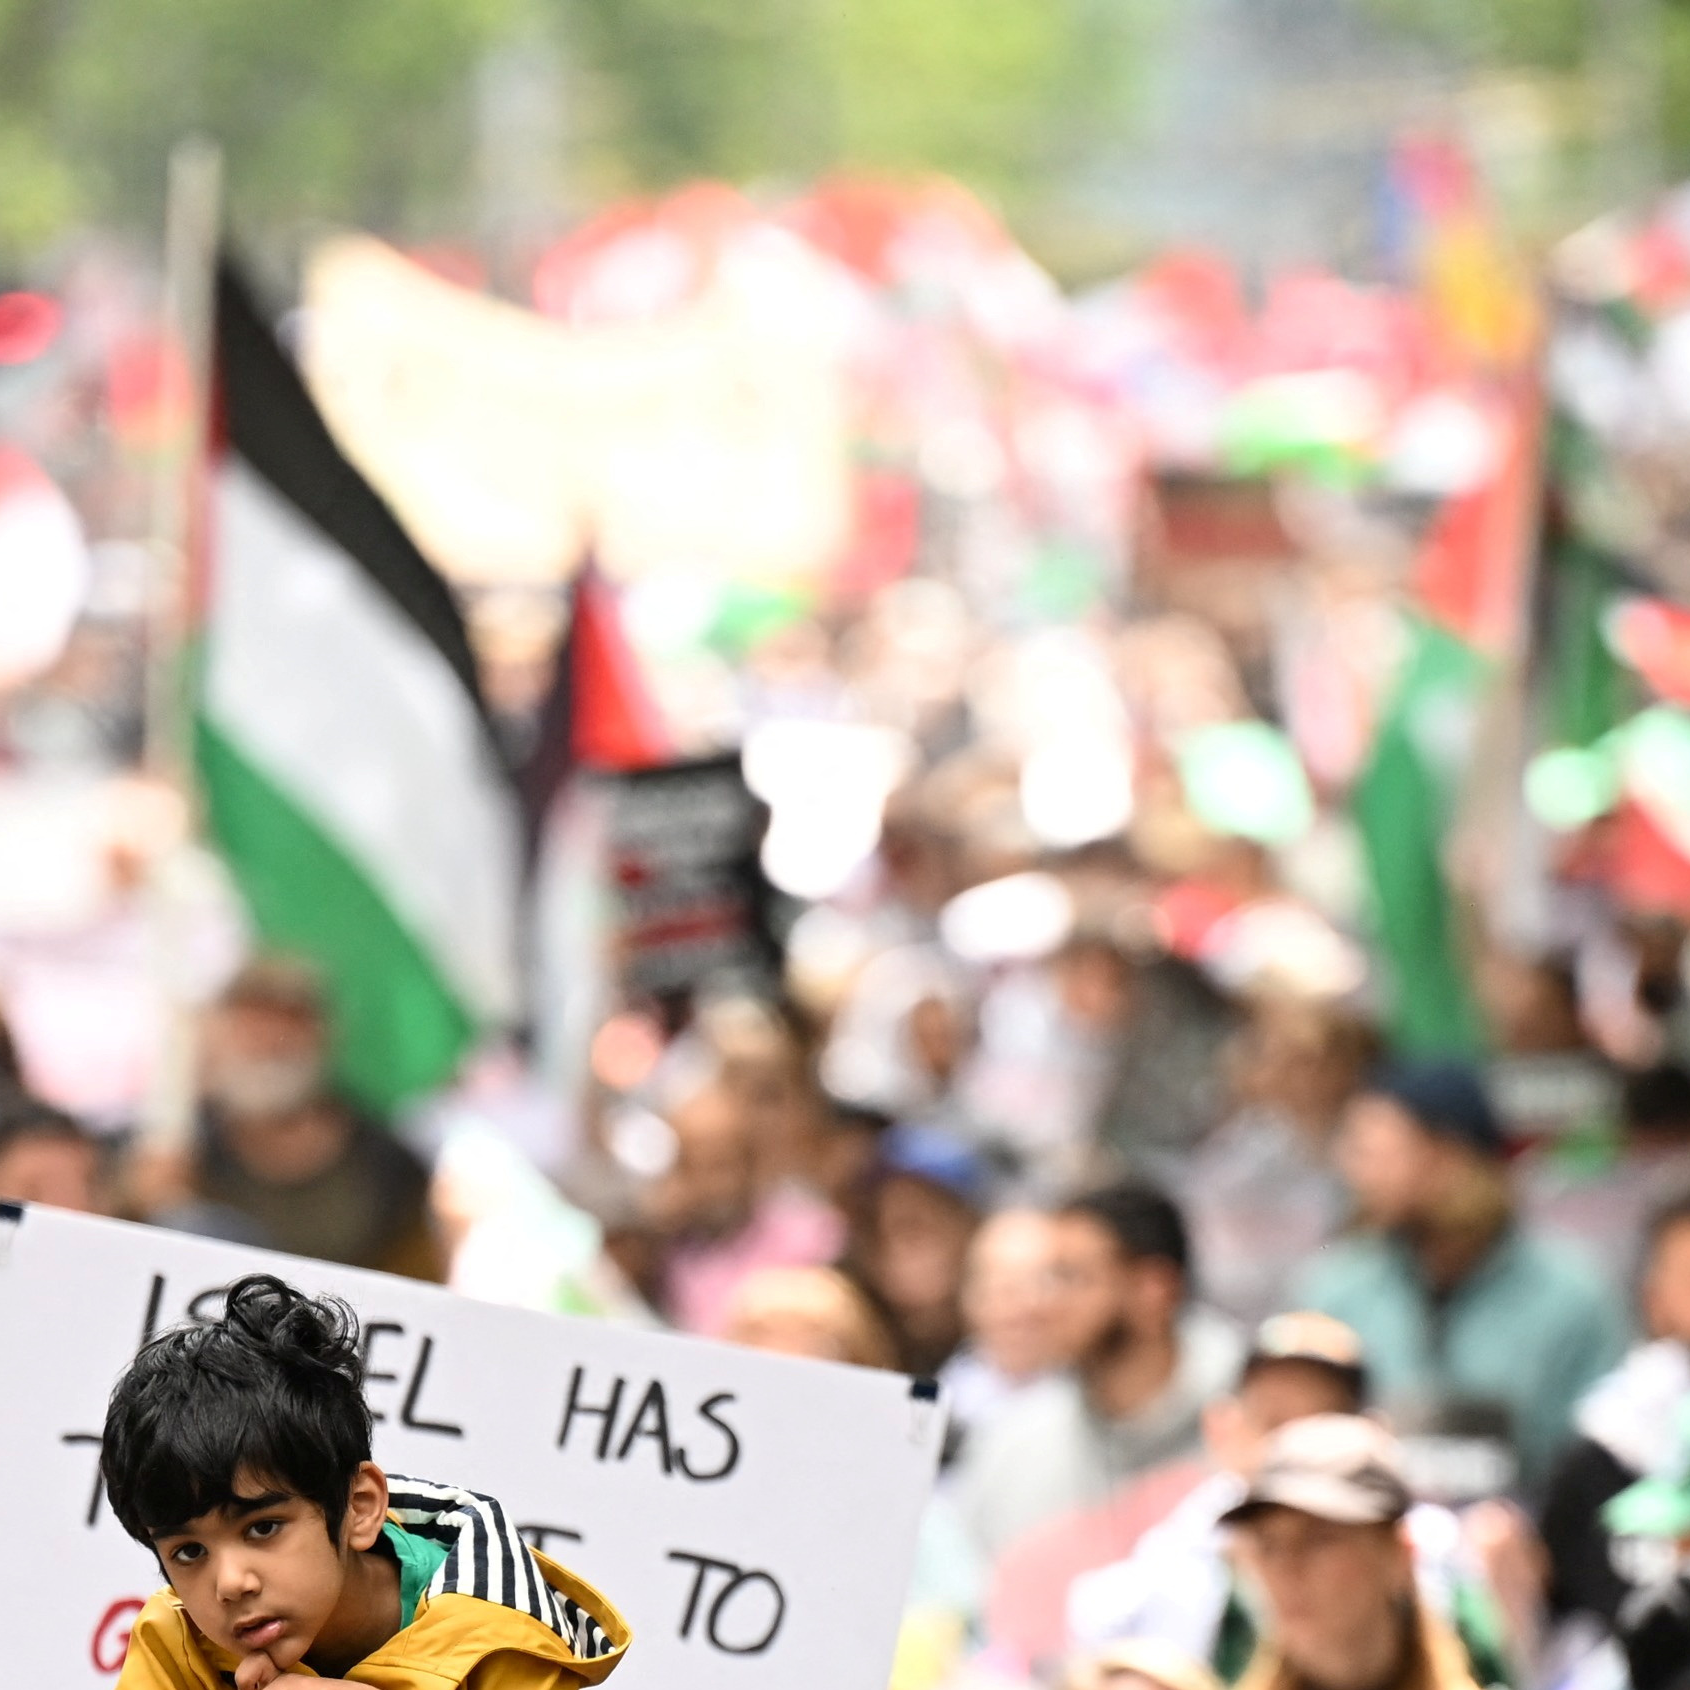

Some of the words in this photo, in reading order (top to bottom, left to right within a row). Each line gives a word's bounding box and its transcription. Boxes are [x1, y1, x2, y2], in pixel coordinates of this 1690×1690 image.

[142, 1273, 463, 1437] IEL
[557, 1365, 740, 1482] HAS
[666, 1548, 787, 1657] TO
